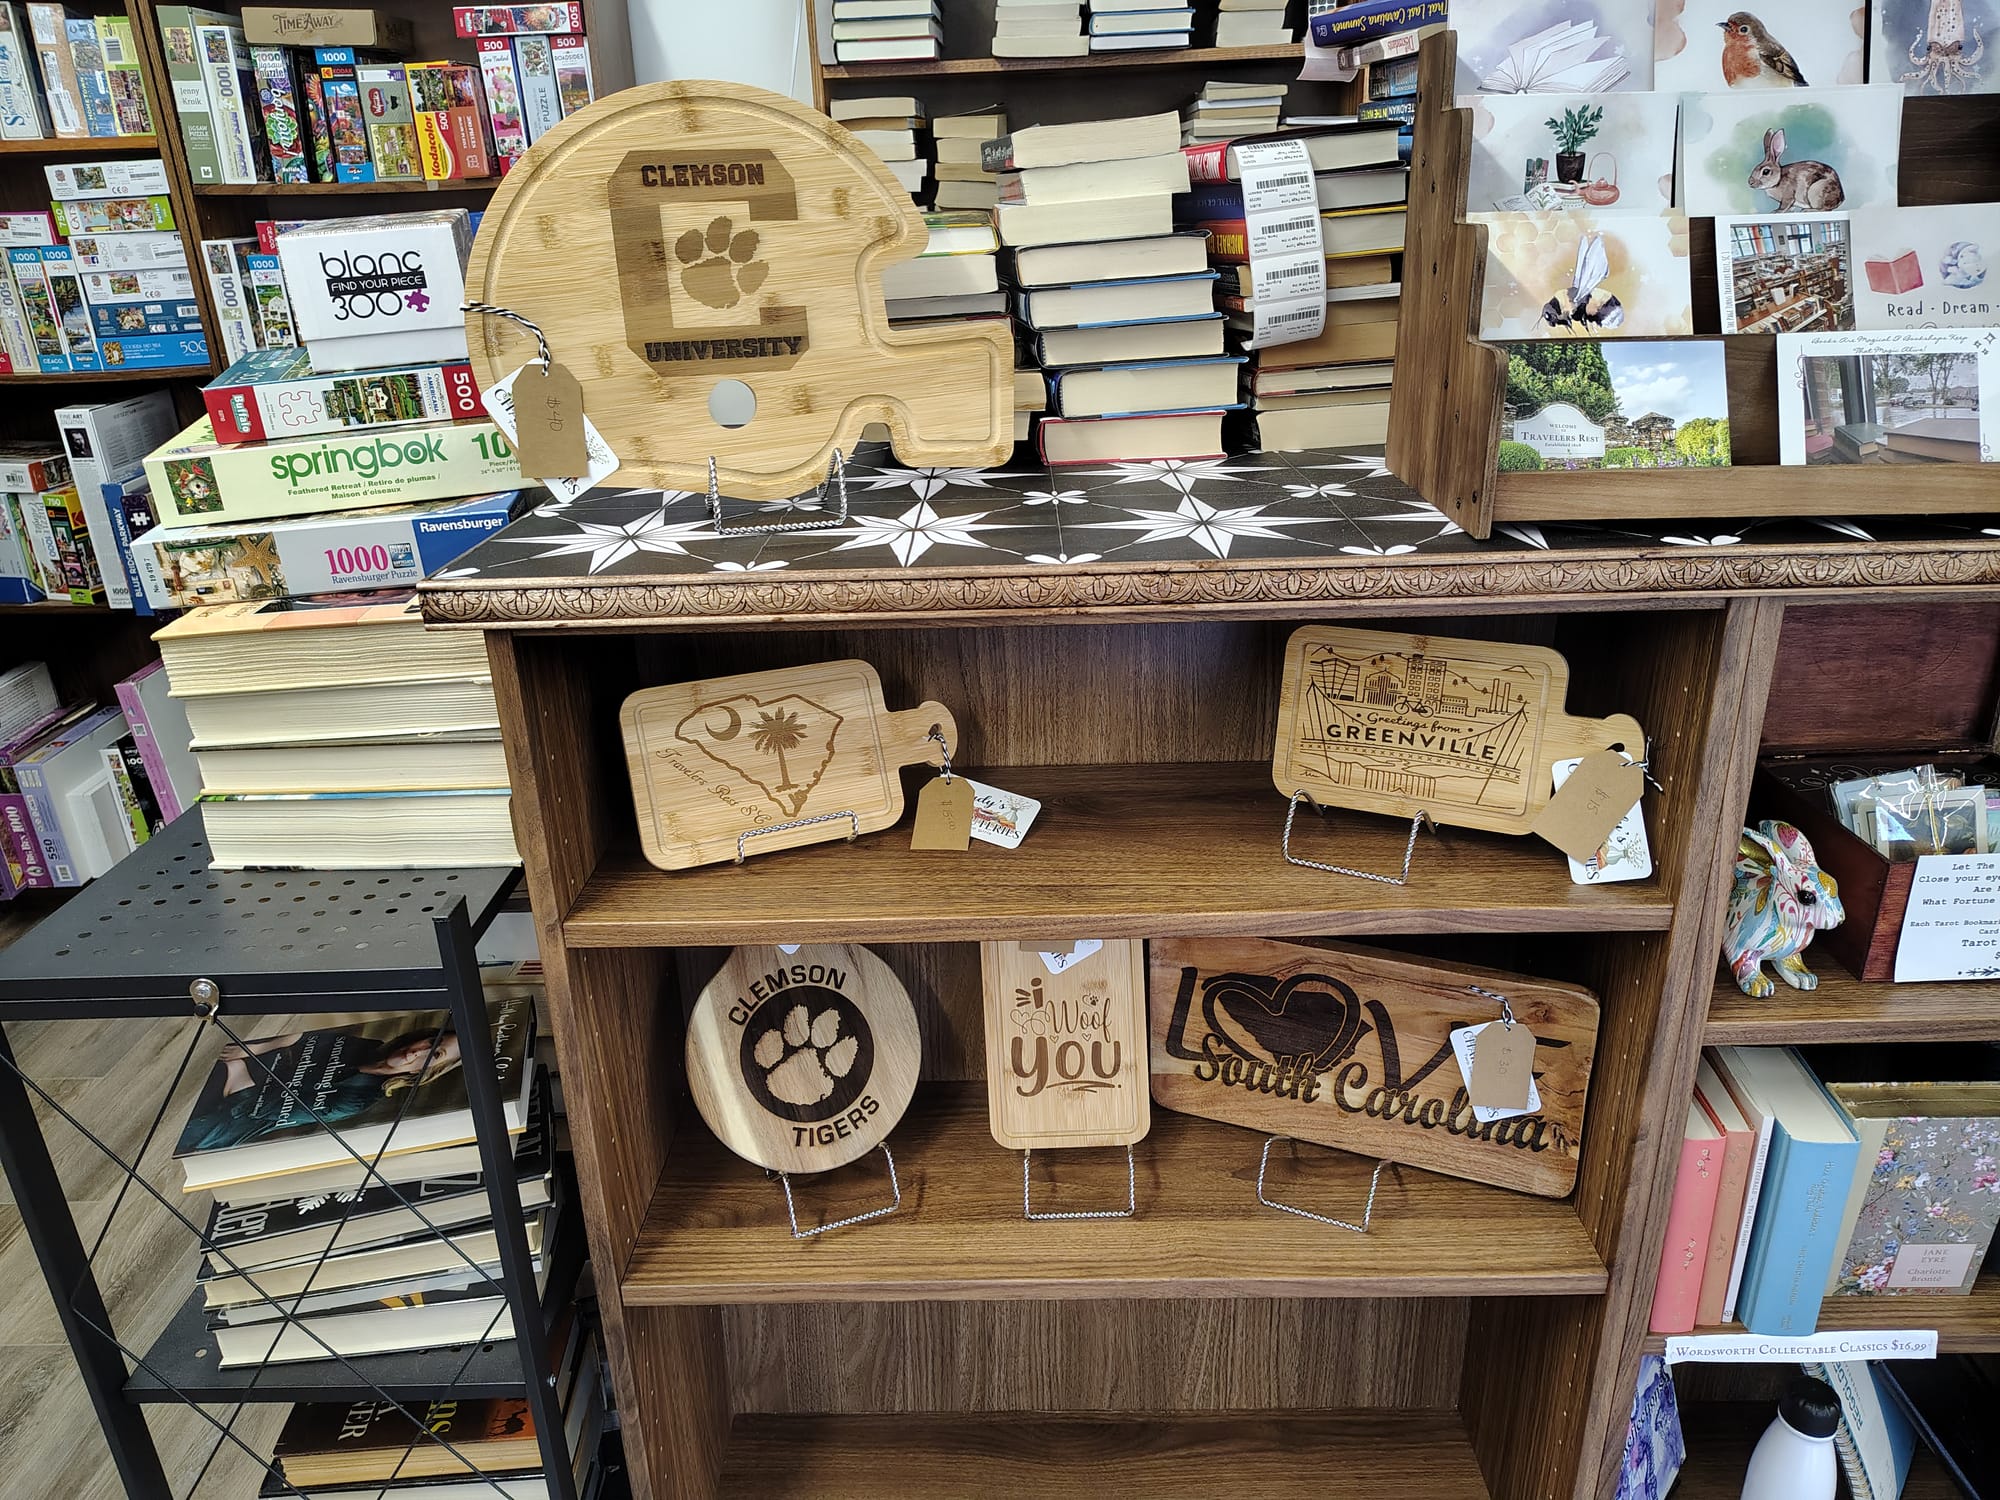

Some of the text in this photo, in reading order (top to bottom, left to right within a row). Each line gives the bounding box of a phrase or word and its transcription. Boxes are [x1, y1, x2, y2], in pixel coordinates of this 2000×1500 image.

[1369, 8, 1405, 28] Carolina
[1408, 5, 1425, 20] Last
[1332, 16, 1366, 34] Summer
[483, 41, 503, 50] 500
[557, 37, 576, 47] 500
[322, 52, 347, 62] 1000
[180, 87, 200, 97] Jenny
[215, 66, 234, 97] 1000
[539, 87, 551, 123] PUZZLE
[439, 112, 448, 131] 500
[424, 115, 441, 177] Kodacolor
[641, 163, 765, 187] CLEMSON
[56, 209, 65, 228] 750
[14, 253, 36, 262] 1000
[45, 250, 67, 260] 1000
[252, 259, 275, 269] 1000
[319, 250, 424, 278] blanc
[16, 264, 41, 273] DAVID
[220, 276, 238, 308] 1000
[331, 275, 424, 293] FIND YOUR PIECE
[332, 291, 403, 321] 300
[1888, 301, 1990, 317] Read Dream
[644, 335, 802, 362] UNIVERSITY
[427, 377, 438, 412] AMERICANA
[453, 372, 475, 411] 500
[234, 394, 251, 433] Buffalo
[1521, 431, 1600, 443] TRAVELERS REST
[270, 432, 448, 487] springbok
[288, 473, 434, 496] Feathered Retreat Retiro de plumas
[331, 486, 402, 500] Maison d'oiseaux
[420, 516, 504, 534] Ravensburger
[46, 536, 57, 558] 1000
[112, 507, 143, 598] BLUE RIDGE PARKWAY
[324, 544, 390, 575] 1000
[332, 569, 418, 585] Ravensburger Puzzle
[1367, 712, 1463, 735] Greetings from
[1327, 723, 1497, 761] GREENVILLE
[656, 747, 708, 787] Travelers
[707, 784, 738, 807] Rest
[42, 839, 58, 861] 550
[1952, 862, 1995, 871] Let The
[1954, 875, 1981, 884] your
[1922, 897, 1996, 906] What Fortune
[1961, 939, 1998, 947] Tarot
[729, 965, 846, 1027] CLEMSON
[1043, 996, 1114, 1044] Woof
[286, 1035, 318, 1088] something
[312, 1036, 346, 1112] something lost
[1194, 1033, 1549, 1153] South Carolina
[792, 1095, 880, 1148] TIGERS
[1922, 1249, 1947, 1257] JANE
[1907, 1268, 1951, 1276] Charlotte
[1676, 1339, 1928, 1357] WORDSWORTH COLLECTABLE CLASSICS $16.99
